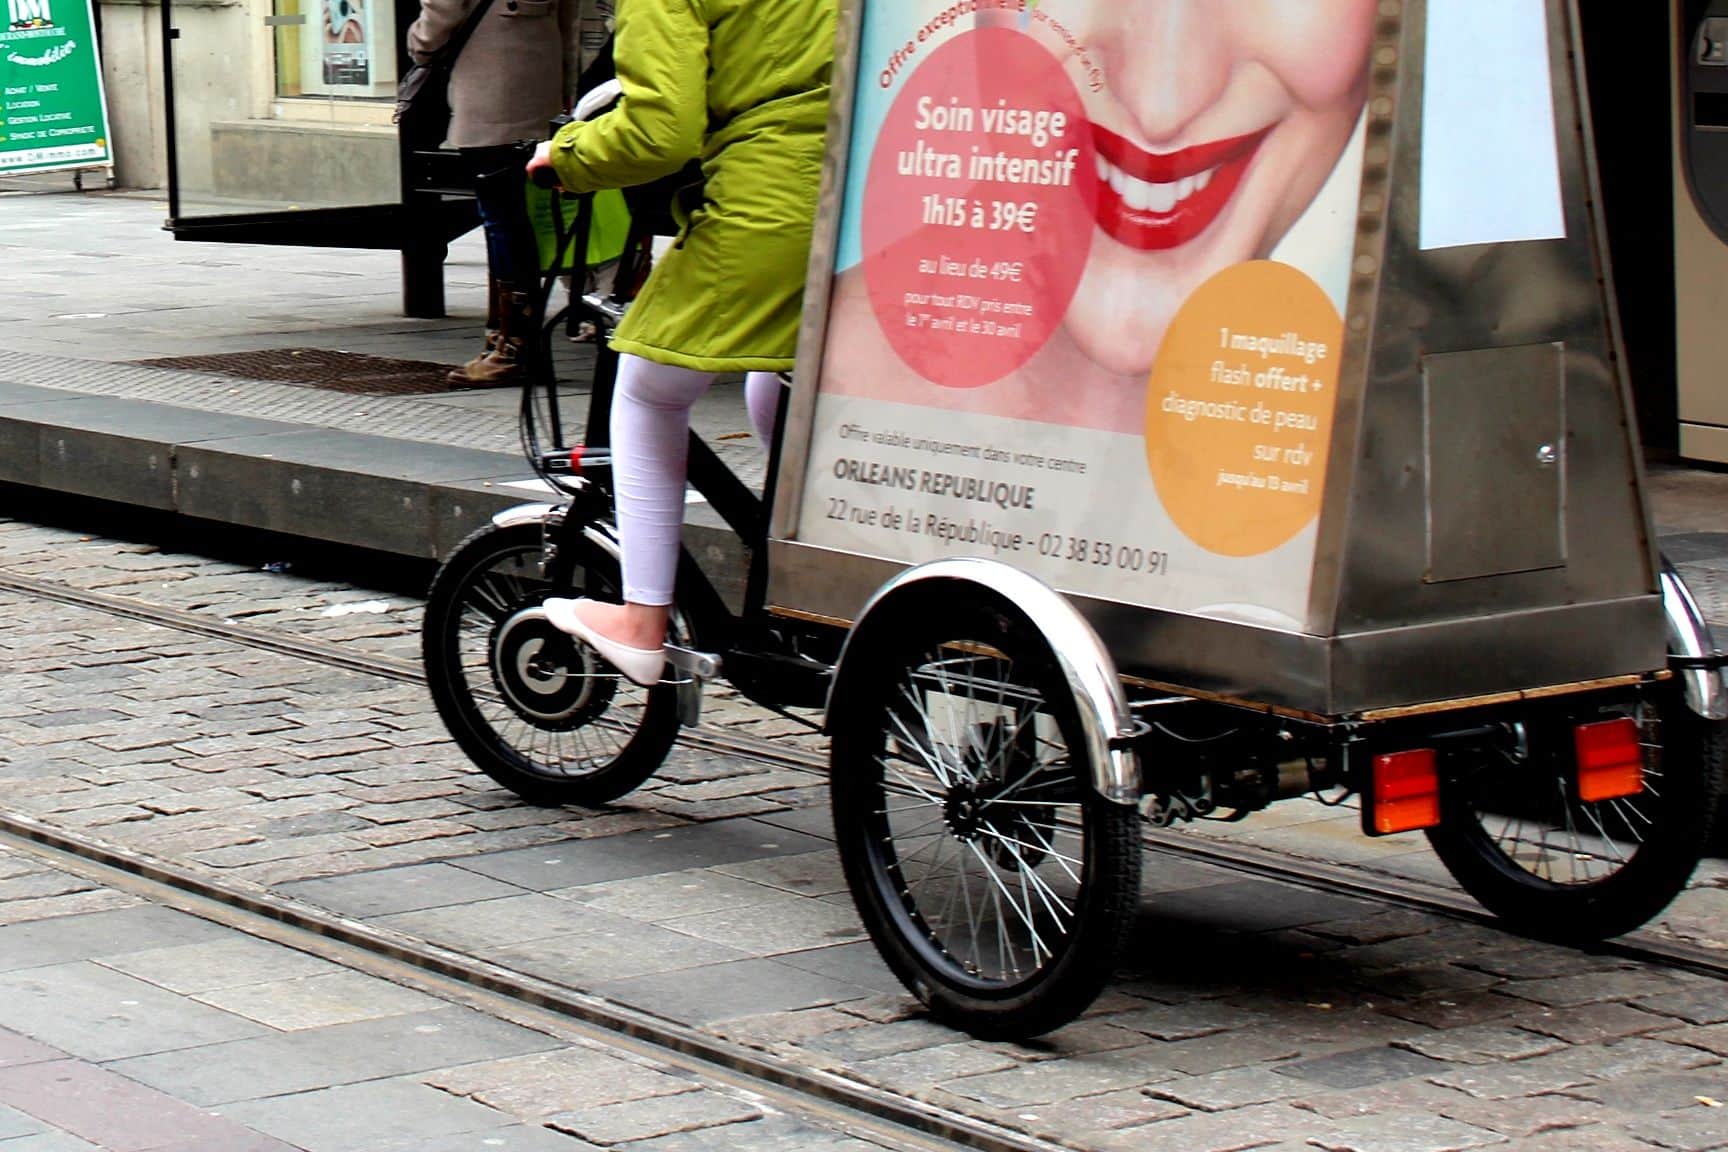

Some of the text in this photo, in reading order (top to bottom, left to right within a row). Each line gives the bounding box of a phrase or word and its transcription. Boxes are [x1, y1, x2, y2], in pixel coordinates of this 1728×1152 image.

[879, 40, 916, 89] Offre
[914, 95, 1067, 148] Soin visage
[897, 139, 1079, 186] ultra intensif
[922, 193, 1039, 233] 1h15 à 39€
[918, 258, 938, 274] au
[938, 254, 967, 277] lieu
[968, 257, 989, 279] de
[1219, 327, 1328, 365] 1 maquillage
[1210, 360, 1323, 393] flash offert +
[1160, 391, 1318, 433] diagnostic de peau
[838, 422, 1087, 475] Offre valable uniquement dans votre centre
[1253, 443, 1313, 466] sur rdv
[832, 457, 1036, 511] ORLEANS REPUBLIQUE
[1281, 476, 1310, 495] avril
[826, 497, 848, 521] 22
[849, 505, 878, 527] rue
[879, 504, 904, 531] de
[905, 509, 922, 535] la
[924, 513, 1024, 556] République
[1038, 532, 1064, 559] 02
[1065, 536, 1089, 563] 38
[1091, 540, 1114, 567] 53
[1117, 545, 1144, 573] 00
[1147, 550, 1170, 577] 91
